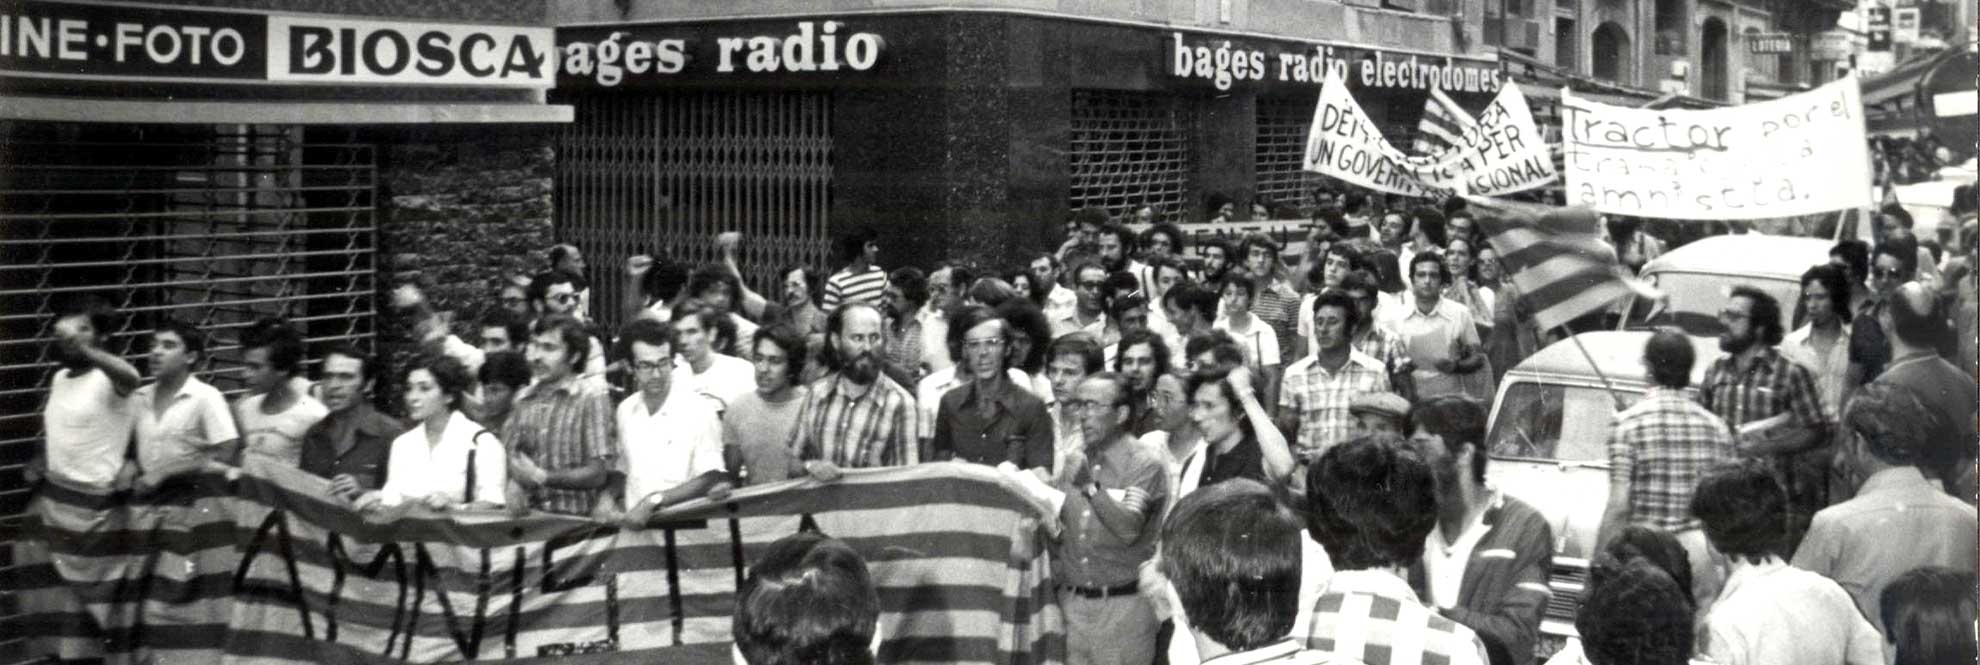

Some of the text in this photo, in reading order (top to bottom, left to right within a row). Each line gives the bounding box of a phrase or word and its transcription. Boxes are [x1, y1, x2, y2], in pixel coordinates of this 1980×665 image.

[289, 25, 545, 78] BIOSCA
[553, 21, 881, 86] ages radio
[1173, 32, 1499, 93] bages radio electrodomes
[1478, 124, 1526, 166] PER
[1561, 104, 1732, 149] Tractor
[1310, 138, 1336, 166] UN
[1475, 155, 1551, 194] SIONAL
[232, 504, 822, 661] AMNISTI
